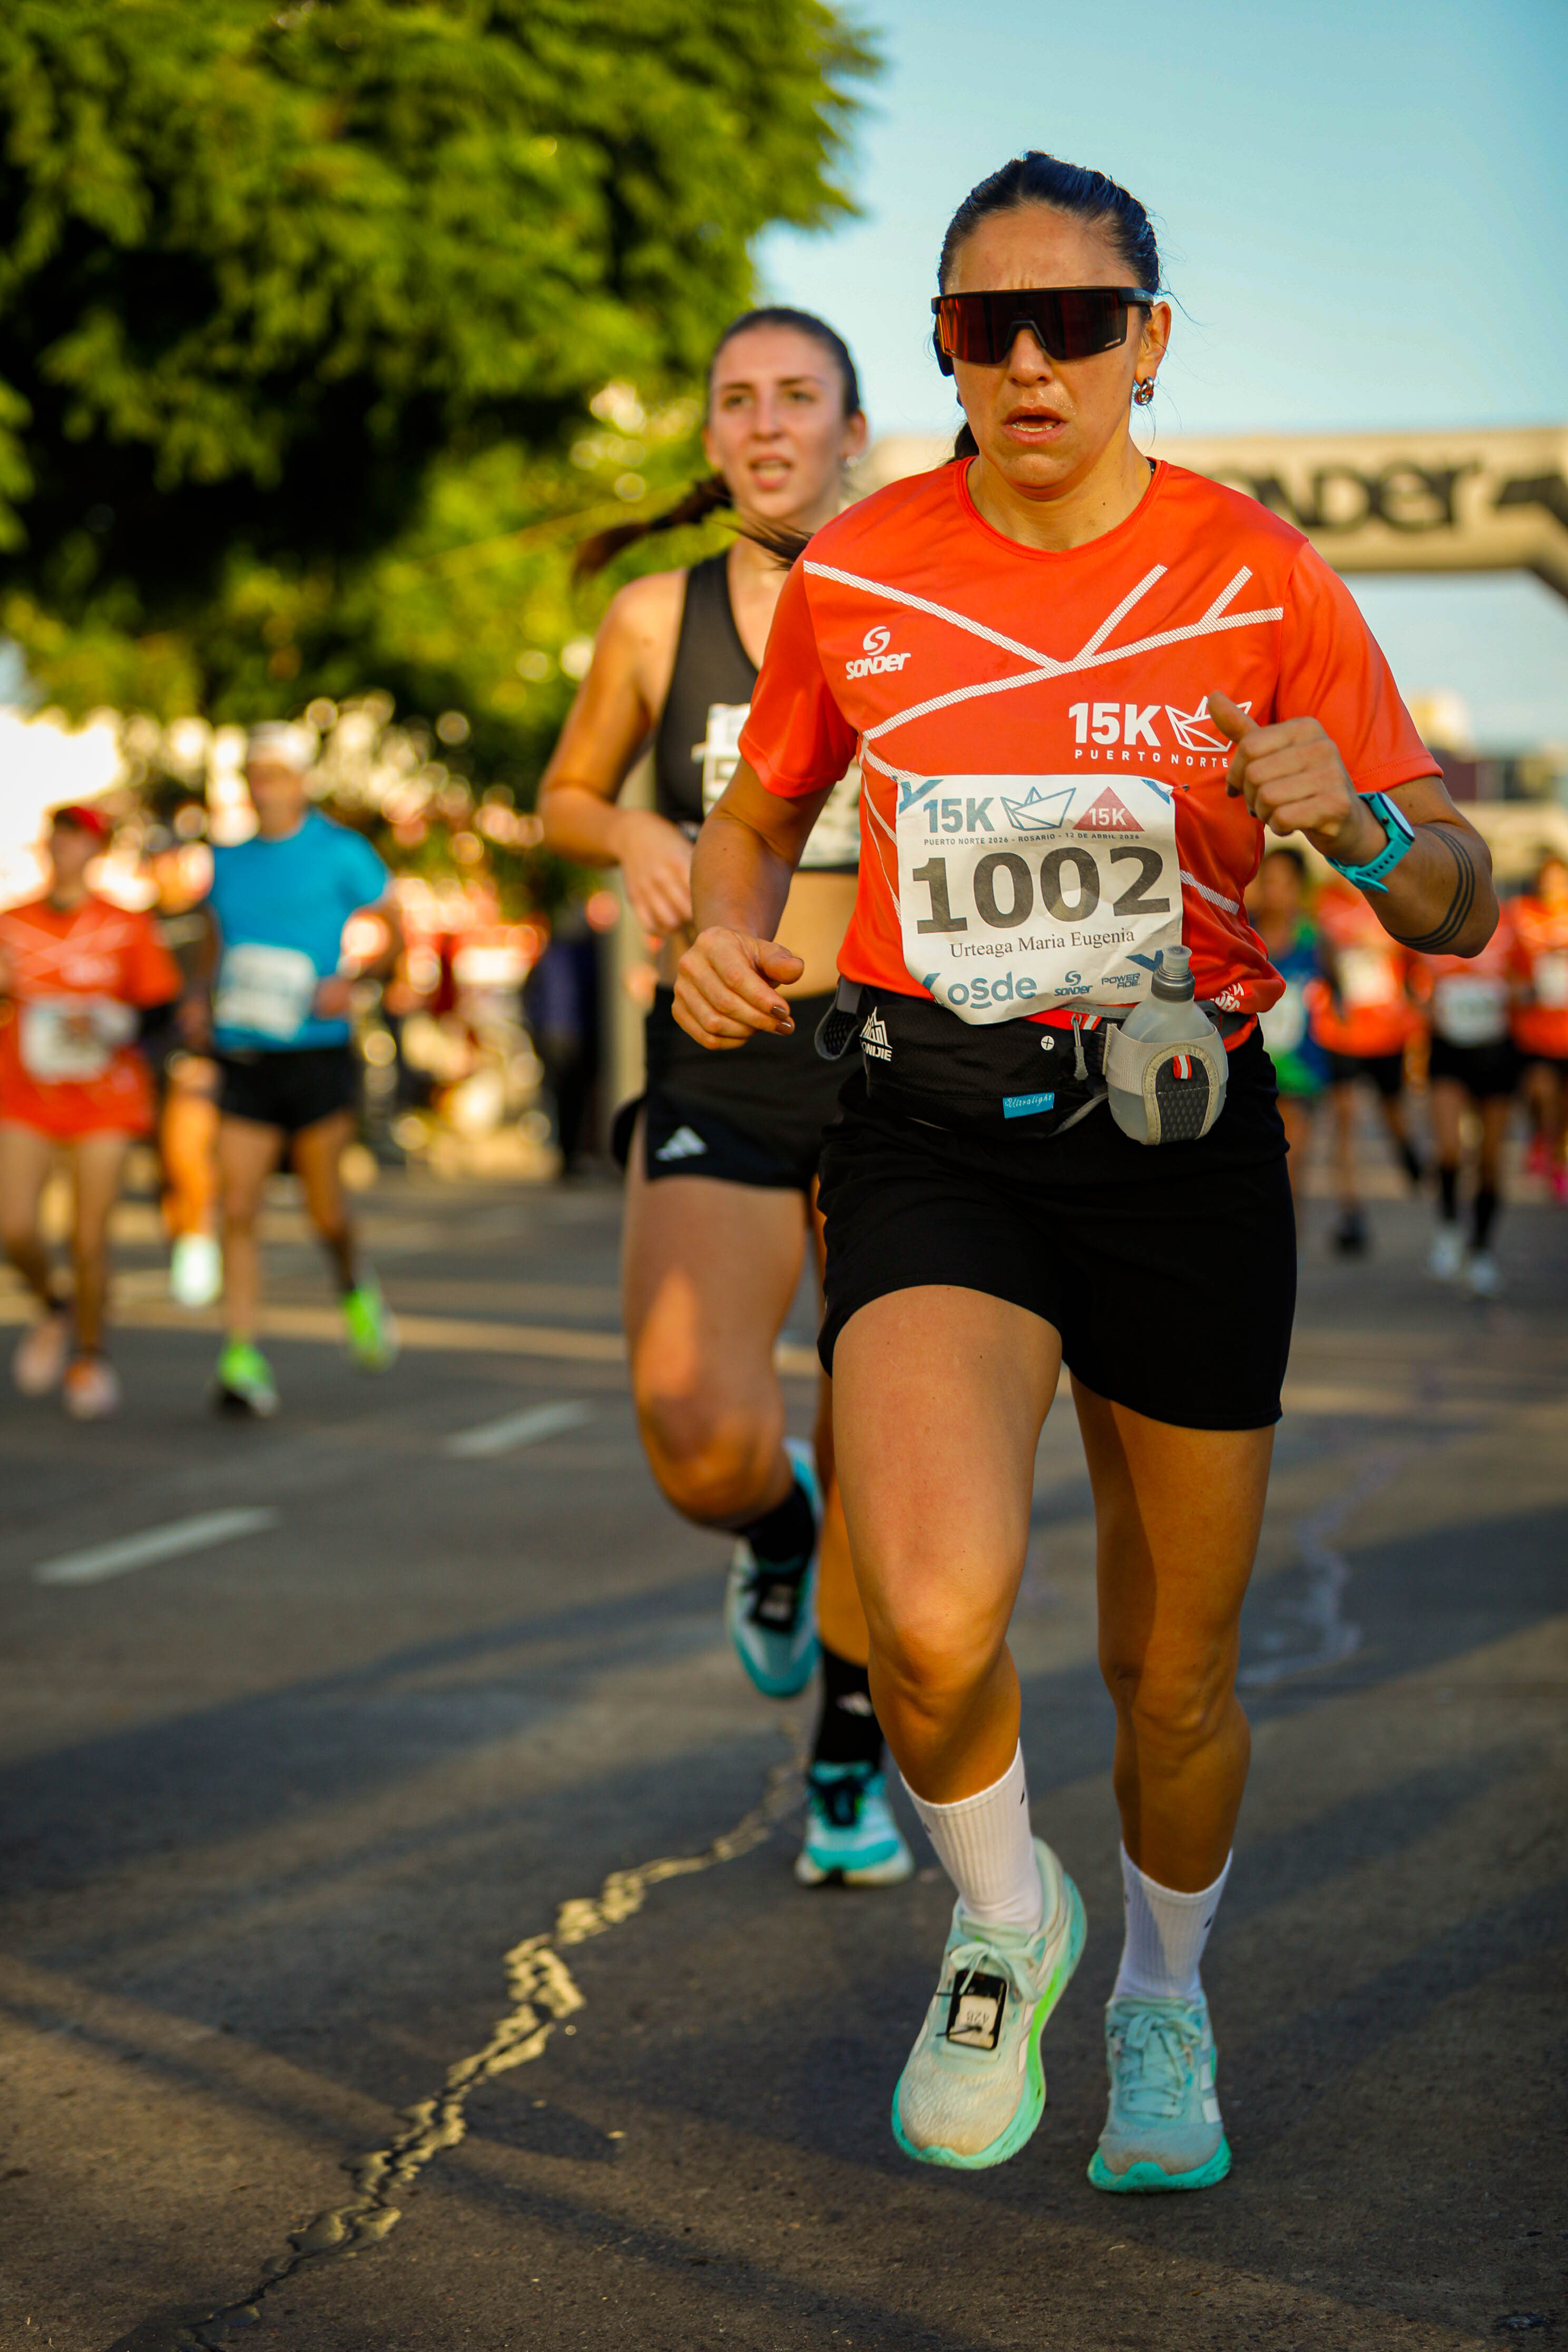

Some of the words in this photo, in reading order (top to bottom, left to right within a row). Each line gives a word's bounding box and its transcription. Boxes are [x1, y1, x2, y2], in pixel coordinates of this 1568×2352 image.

[1069, 702, 1161, 746] 15K
[1075, 749, 1161, 762] PUERTO
[1171, 754, 1229, 768] NORTE
[923, 797, 995, 833] 15K
[1089, 808, 1128, 827] 15K
[1018, 833, 1055, 842] ROSARIO
[912, 846, 1171, 934] 1002
[950, 942, 1013, 957] Urteaga
[1017, 936, 1065, 951] Maria
[1070, 927, 1135, 948] Eugenia
[947, 971, 1037, 1007] osde
[1102, 973, 1141, 985] POWER
